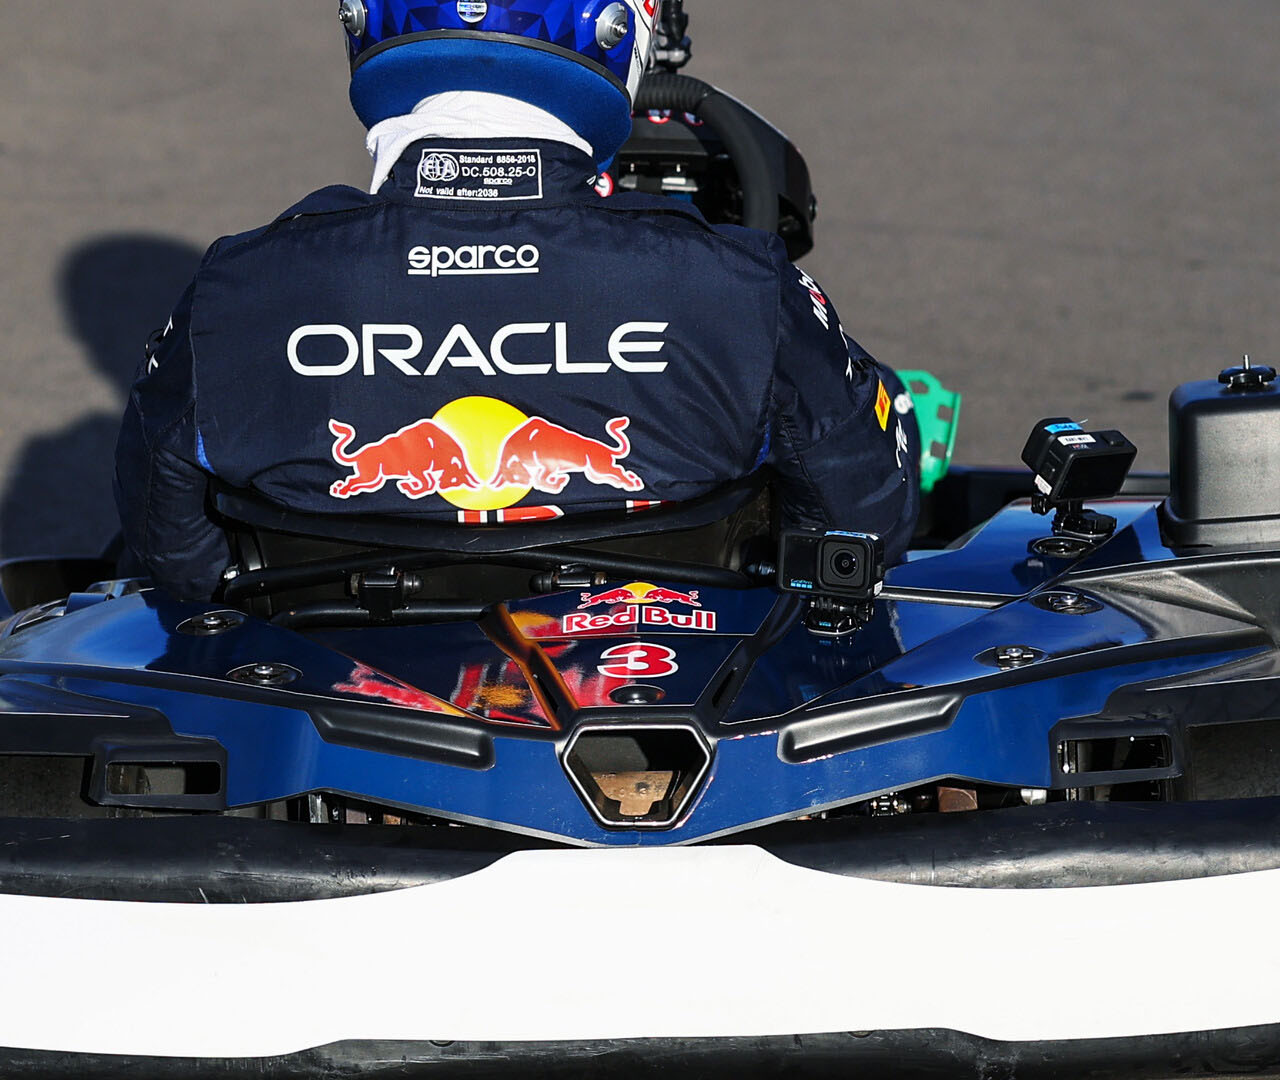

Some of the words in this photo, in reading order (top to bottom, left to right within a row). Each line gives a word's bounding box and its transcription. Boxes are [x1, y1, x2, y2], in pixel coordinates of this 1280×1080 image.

[459, 154, 494, 164] Standard
[419, 186, 433, 195] Not
[436, 187, 454, 196] valid
[408, 244, 539, 277] sparco
[287, 321, 669, 376] ORACLE
[563, 605, 639, 633] Red
[642, 606, 716, 631] Bull
[597, 642, 679, 678] 3
